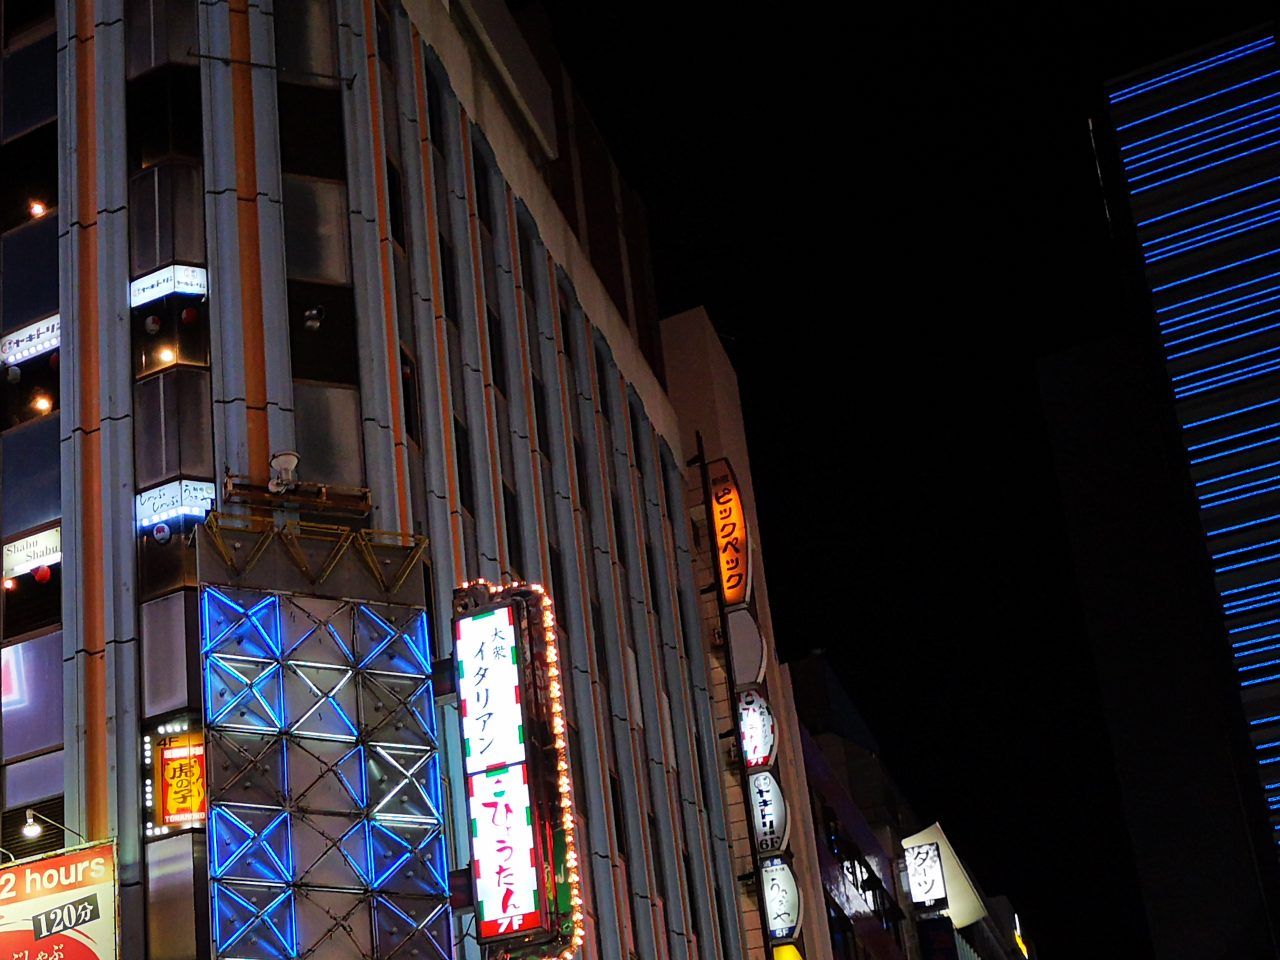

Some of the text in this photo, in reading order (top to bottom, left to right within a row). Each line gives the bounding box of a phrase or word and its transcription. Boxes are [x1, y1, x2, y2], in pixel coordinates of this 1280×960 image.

[6, 537, 38, 556] Shabu
[25, 544, 58, 562] Shabu
[472, 641, 497, 756] イタリアン
[171, 763, 196, 805] 虎の子
[0, 873, 17, 900] 2
[25, 856, 105, 893] hours
[36, 902, 94, 938] 120分
[497, 915, 525, 935] 7F
